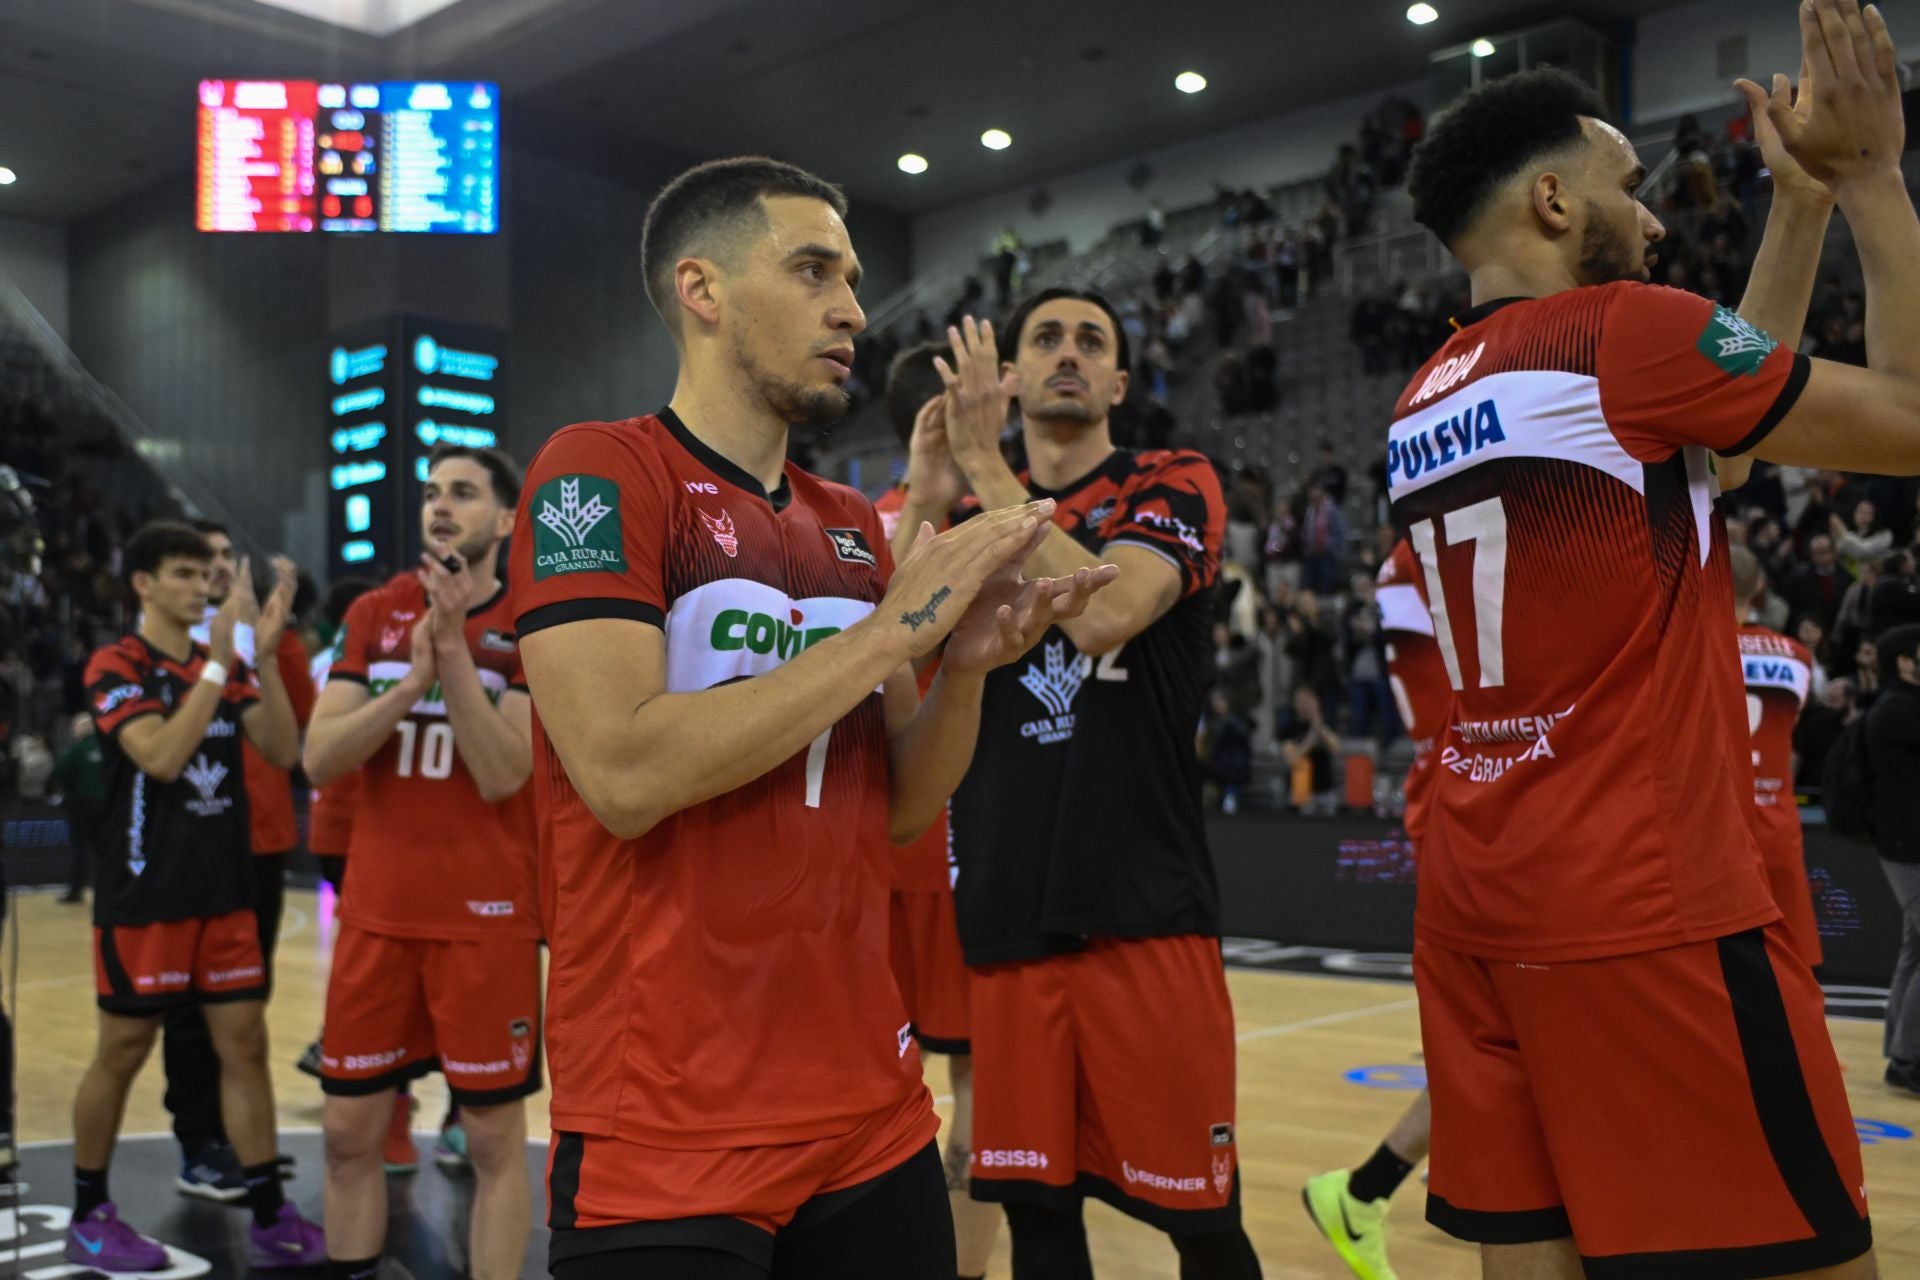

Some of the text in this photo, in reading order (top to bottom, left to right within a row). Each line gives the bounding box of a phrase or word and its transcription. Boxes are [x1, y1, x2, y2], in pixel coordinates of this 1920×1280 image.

[1387, 399, 1506, 489] PULEVA
[537, 548, 620, 567] CAJA RURAL
[555, 559, 604, 573] GRANADA
[1409, 496, 1507, 690] 17
[710, 609, 842, 661] covi
[1745, 662, 1795, 682] EVA
[396, 721, 454, 779] 10
[980, 1150, 1039, 1167] asisa
[1138, 1173, 1206, 1191] BERNER
